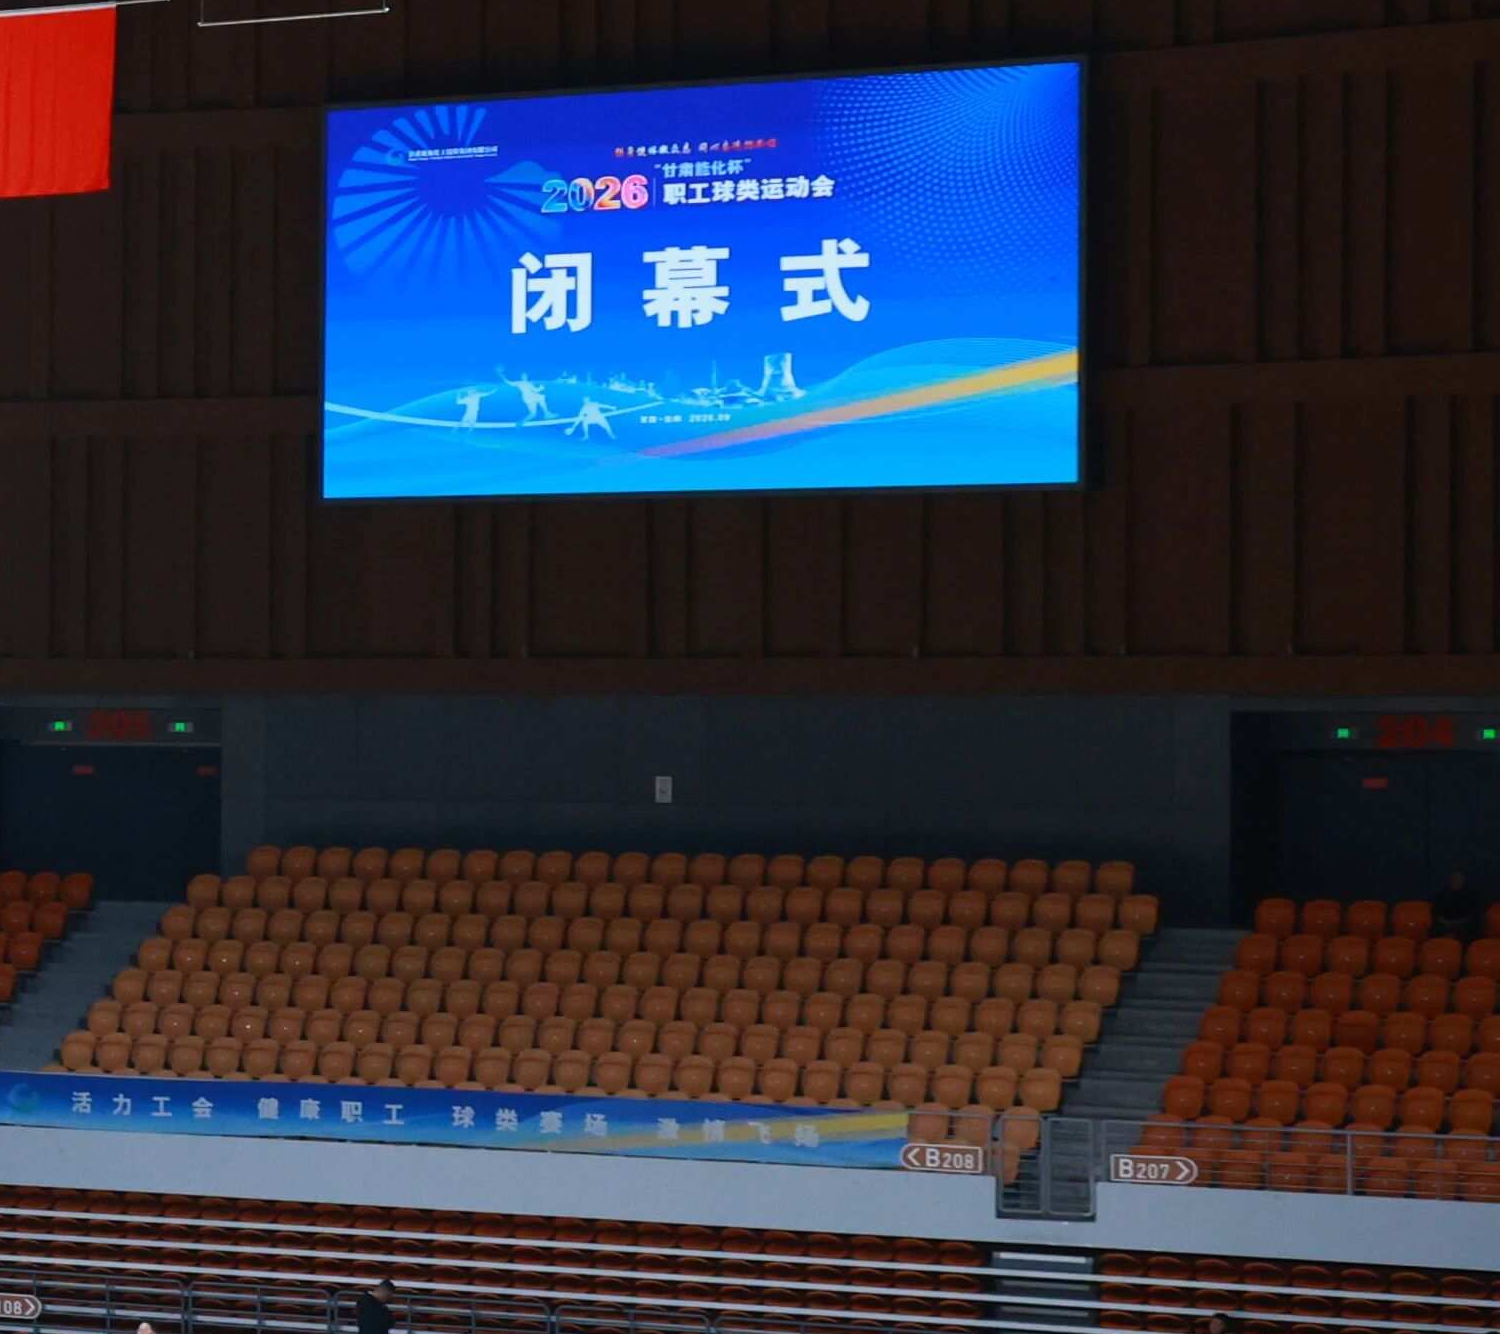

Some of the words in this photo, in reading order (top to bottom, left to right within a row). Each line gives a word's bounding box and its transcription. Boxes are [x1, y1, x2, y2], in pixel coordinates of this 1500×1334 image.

[540, 173, 649, 214] 2026
[662, 174, 836, 206] 职工球类运动会
[509, 238, 870, 334] 闭幕式
[71, 1090, 214, 1121] 活力工会
[257, 1096, 405, 1127] 健康职工
[924, 1145, 976, 1171] B208
[1116, 1154, 1172, 1183] B207
